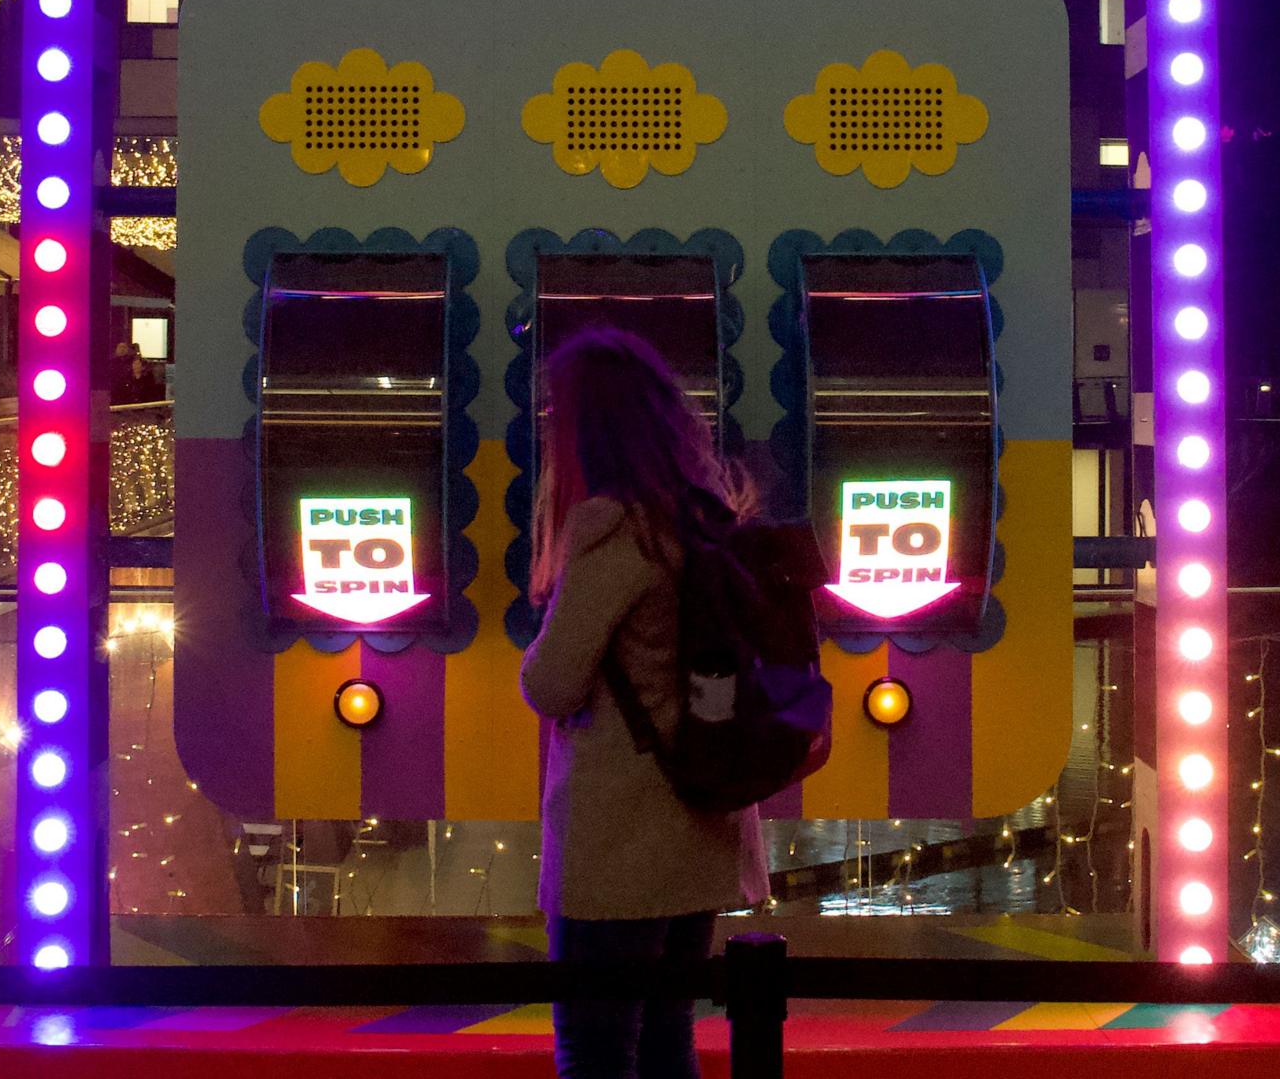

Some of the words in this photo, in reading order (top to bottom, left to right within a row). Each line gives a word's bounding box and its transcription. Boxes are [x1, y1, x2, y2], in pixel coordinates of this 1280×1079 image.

[852, 491, 944, 510] PUSH
[310, 508, 404, 526] PUSH
[849, 522, 942, 556] TO
[308, 538, 405, 569] TO
[847, 567, 942, 583] SPIN
[314, 580, 409, 594] SPIN
